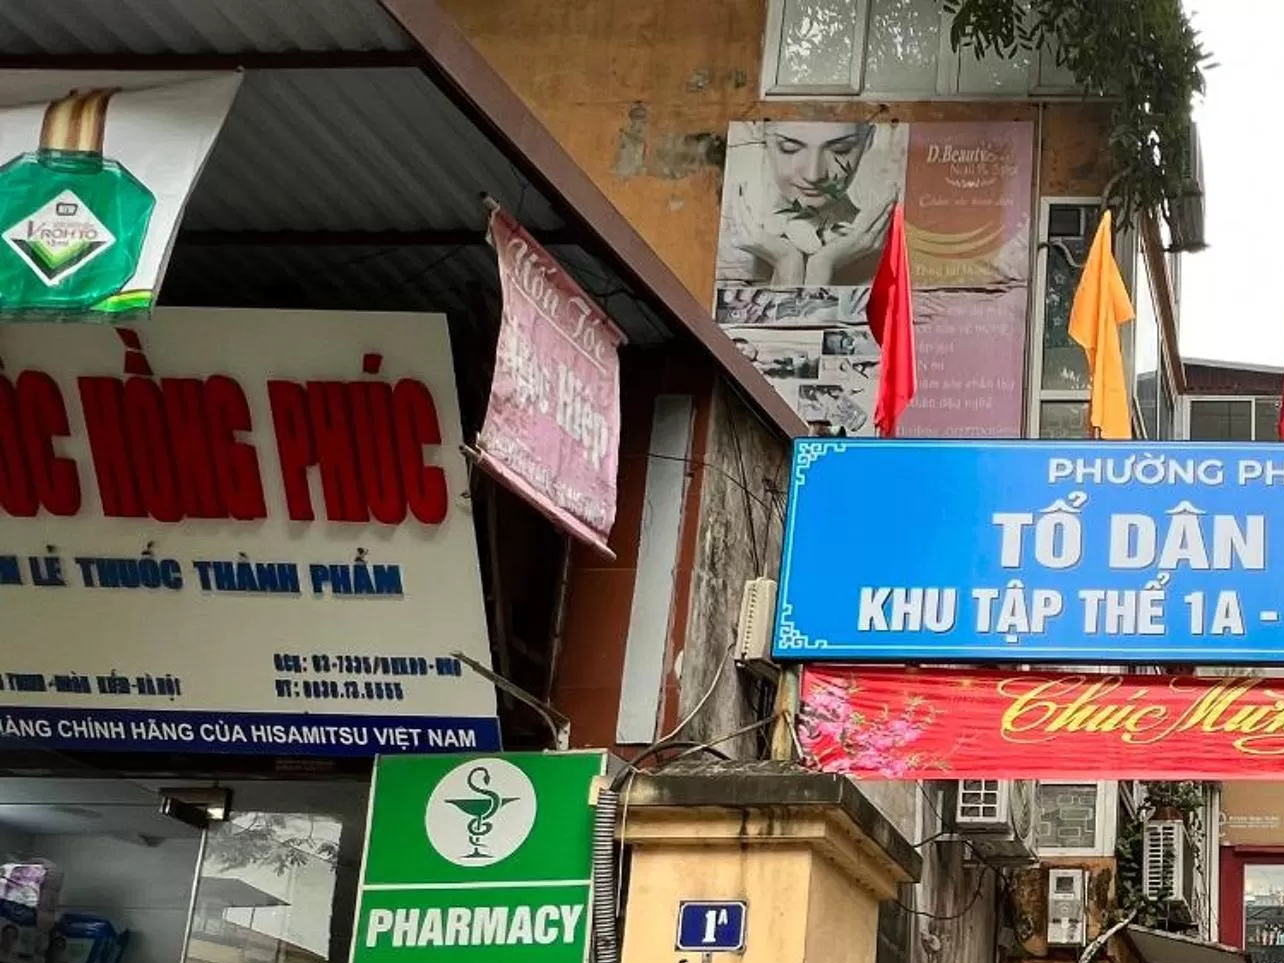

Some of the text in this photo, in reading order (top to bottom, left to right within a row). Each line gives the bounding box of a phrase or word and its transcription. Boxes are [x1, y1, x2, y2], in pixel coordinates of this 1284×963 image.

[77, 327, 267, 523] HỒNG
[267, 354, 448, 525] PHÚC
[1048, 453, 1225, 487] PHƯỜNG
[993, 491, 1088, 570] TỔ
[1109, 500, 1266, 572] DÂN
[857, 587, 957, 633] KHU
[973, 580, 1063, 644] TẬP
[1079, 571, 1171, 635] THỂ
[1184, 592, 1245, 636] 1A
[1260, 611, 1280, 622] -
[57, 716, 126, 740] CHÍNH
[130, 718, 195, 741] HÃNG
[251, 724, 368, 746] HISAMITSU
[373, 726, 422, 751] VIỆT
[428, 729, 477, 748] NAM
[997, 675, 1169, 744] Chúc
[364, 903, 584, 947] PHARMACY
